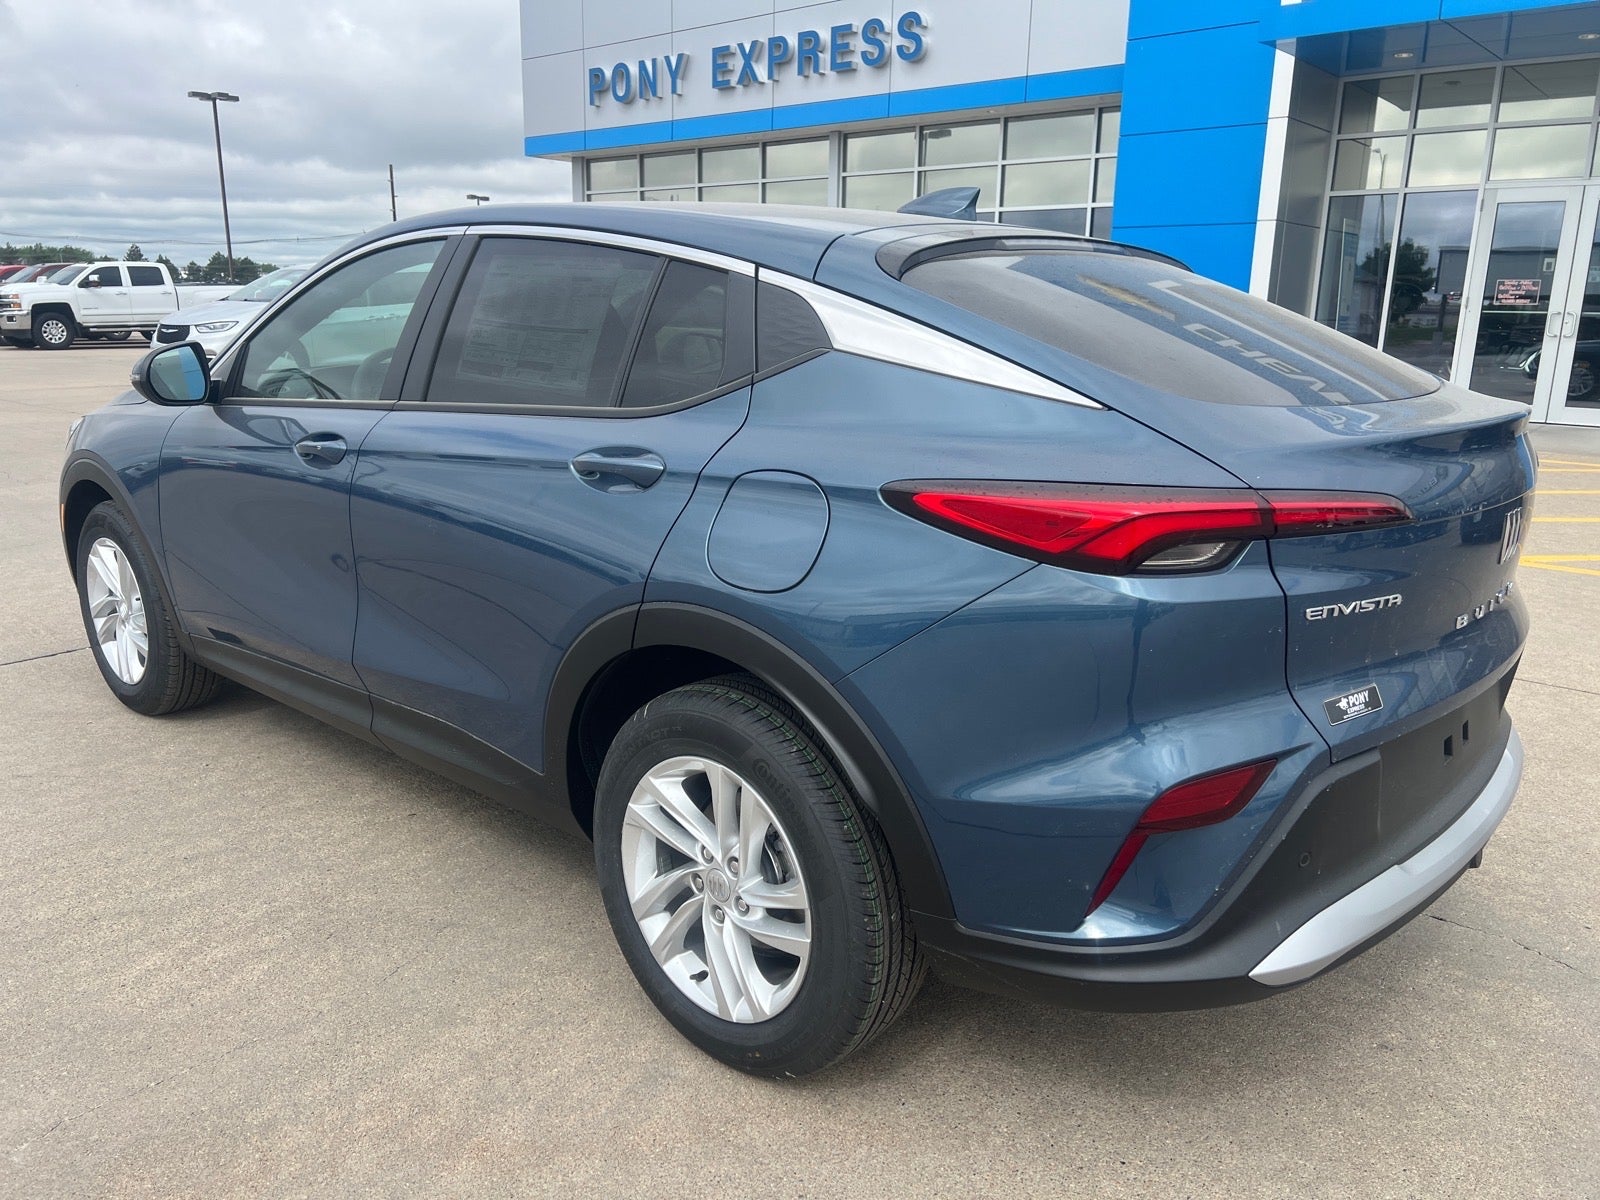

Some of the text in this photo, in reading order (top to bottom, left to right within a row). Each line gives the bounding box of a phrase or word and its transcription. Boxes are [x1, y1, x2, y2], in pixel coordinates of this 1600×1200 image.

[588, 11, 927, 107] PONY EXPRESS
[1306, 593, 1403, 621] ENVISTA
[1348, 690, 1369, 707] PONY
